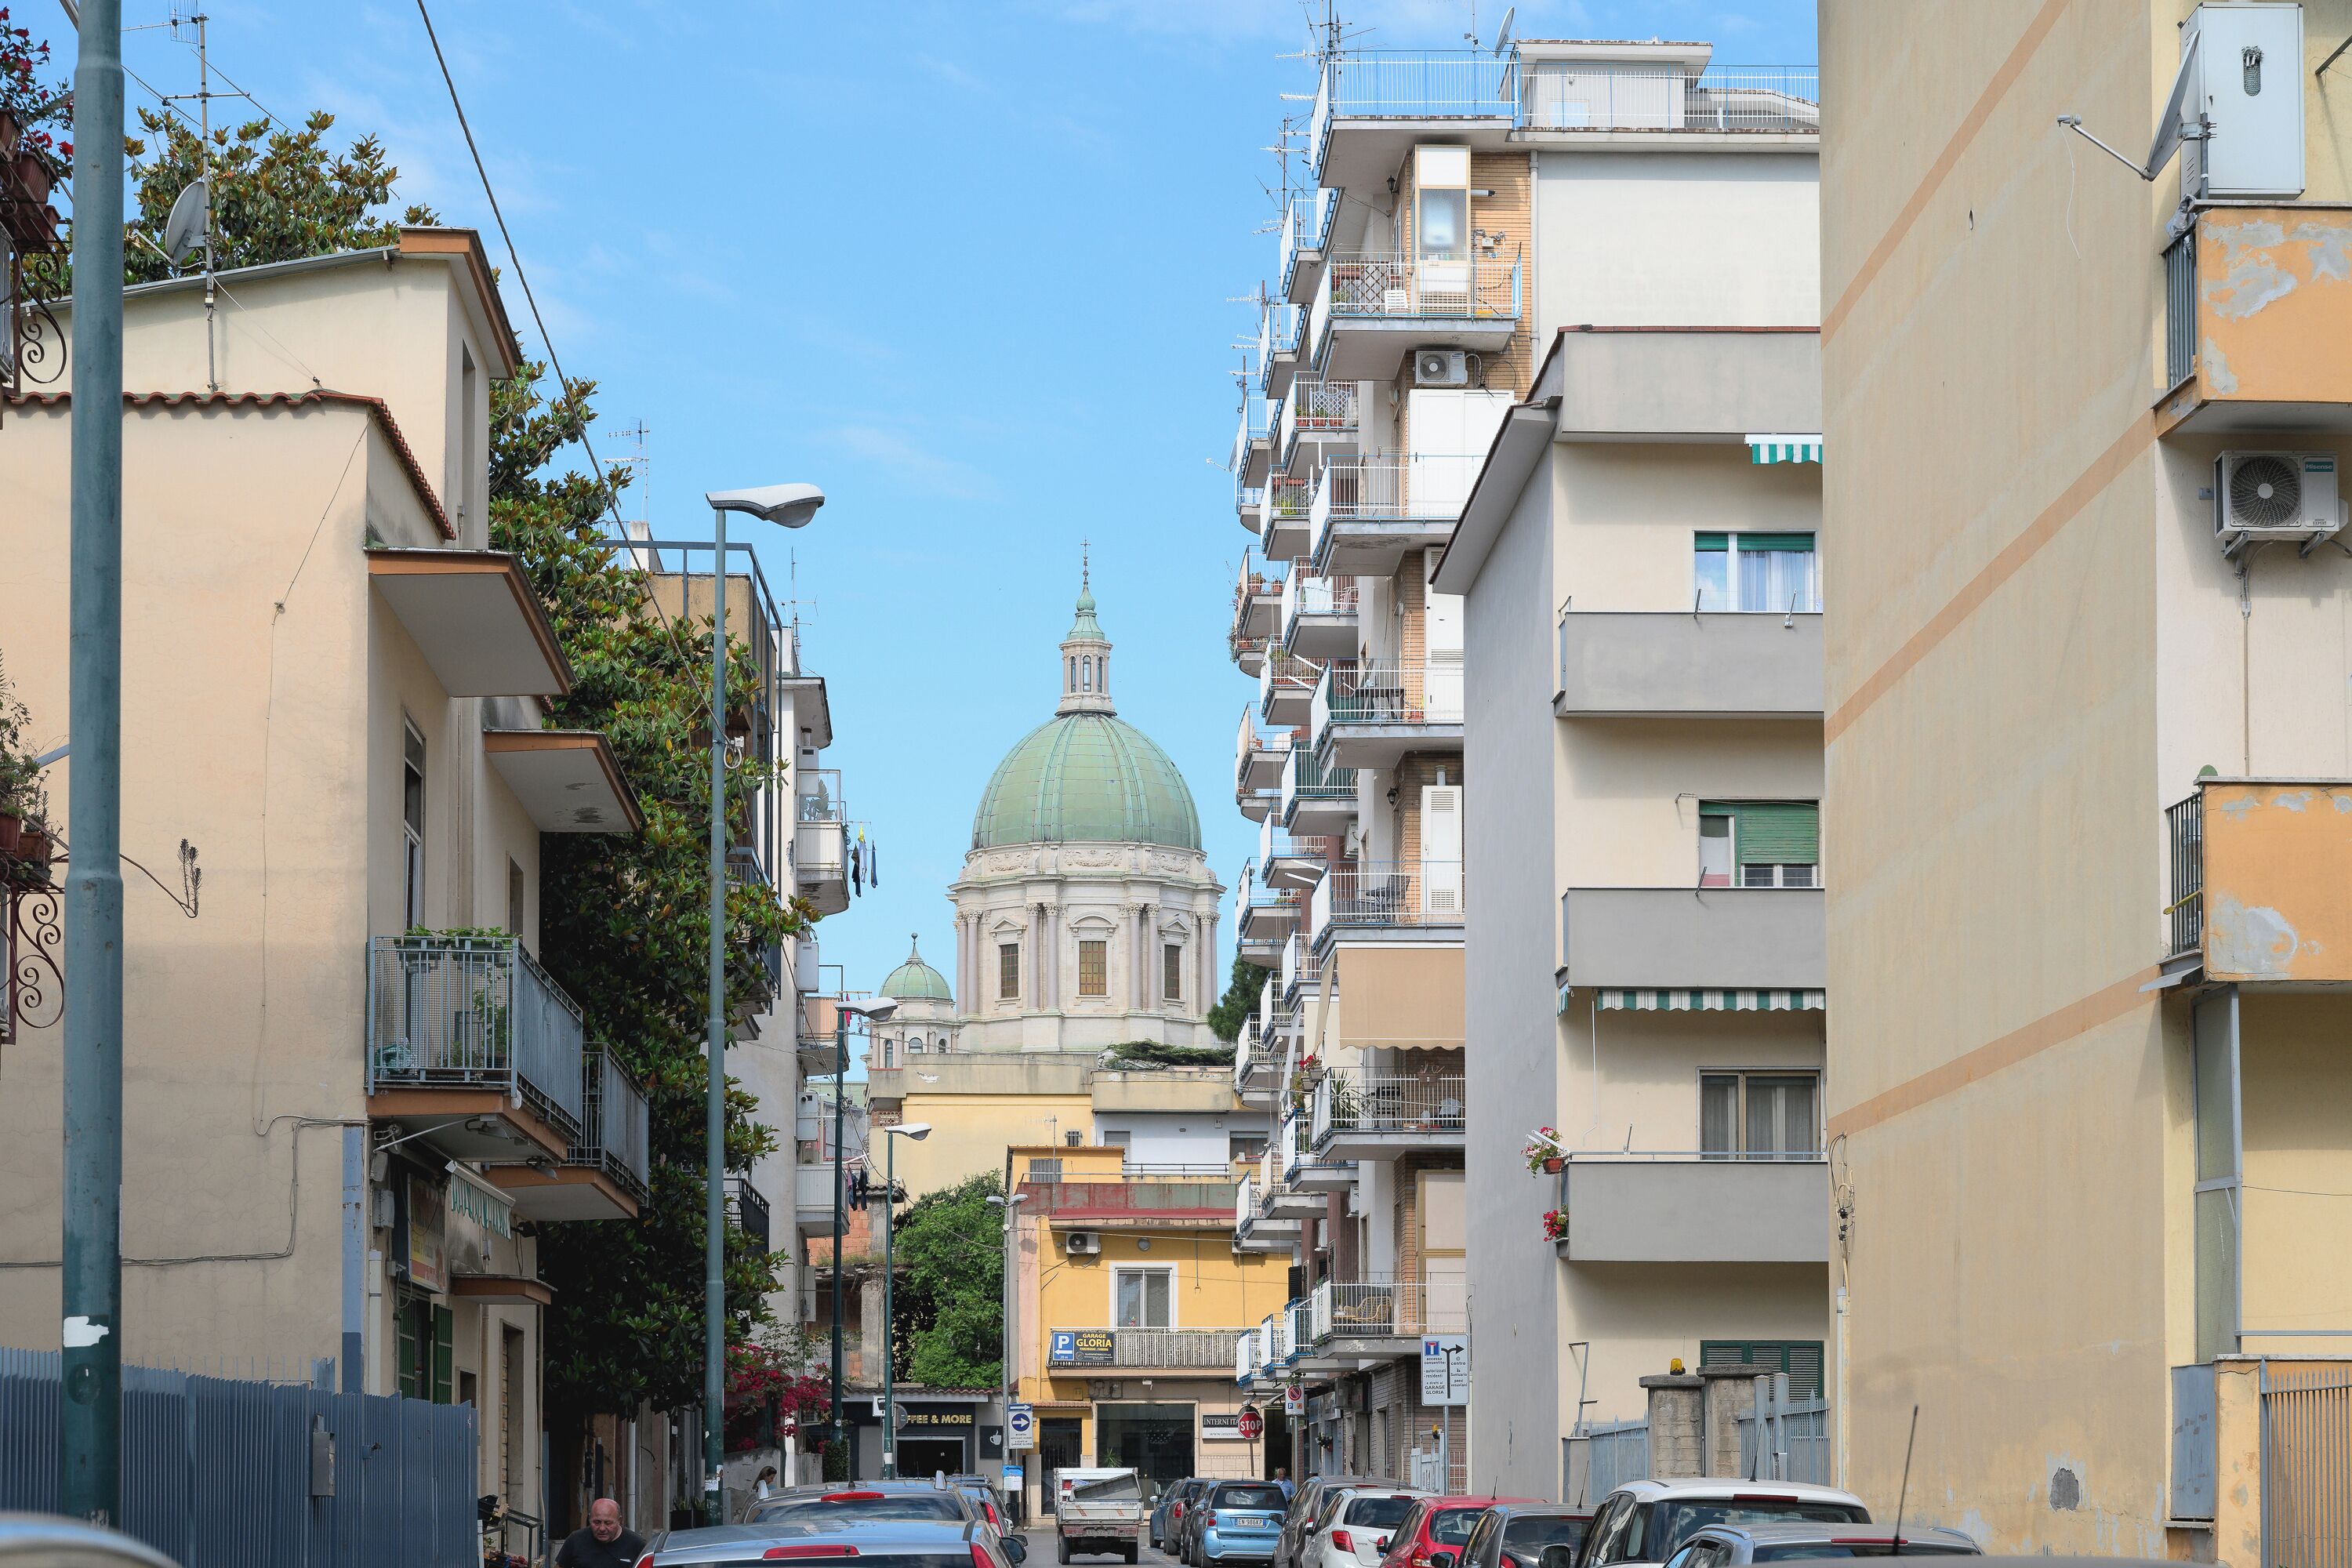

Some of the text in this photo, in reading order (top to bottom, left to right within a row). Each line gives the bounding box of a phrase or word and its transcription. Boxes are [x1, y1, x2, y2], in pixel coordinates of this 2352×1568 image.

[1058, 1335, 1070, 1348] P
[1076, 1338, 1112, 1348] GLORIA
[907, 1414, 972, 1424] FFEE & MORE
[1240, 1421, 1261, 1431] STOP
